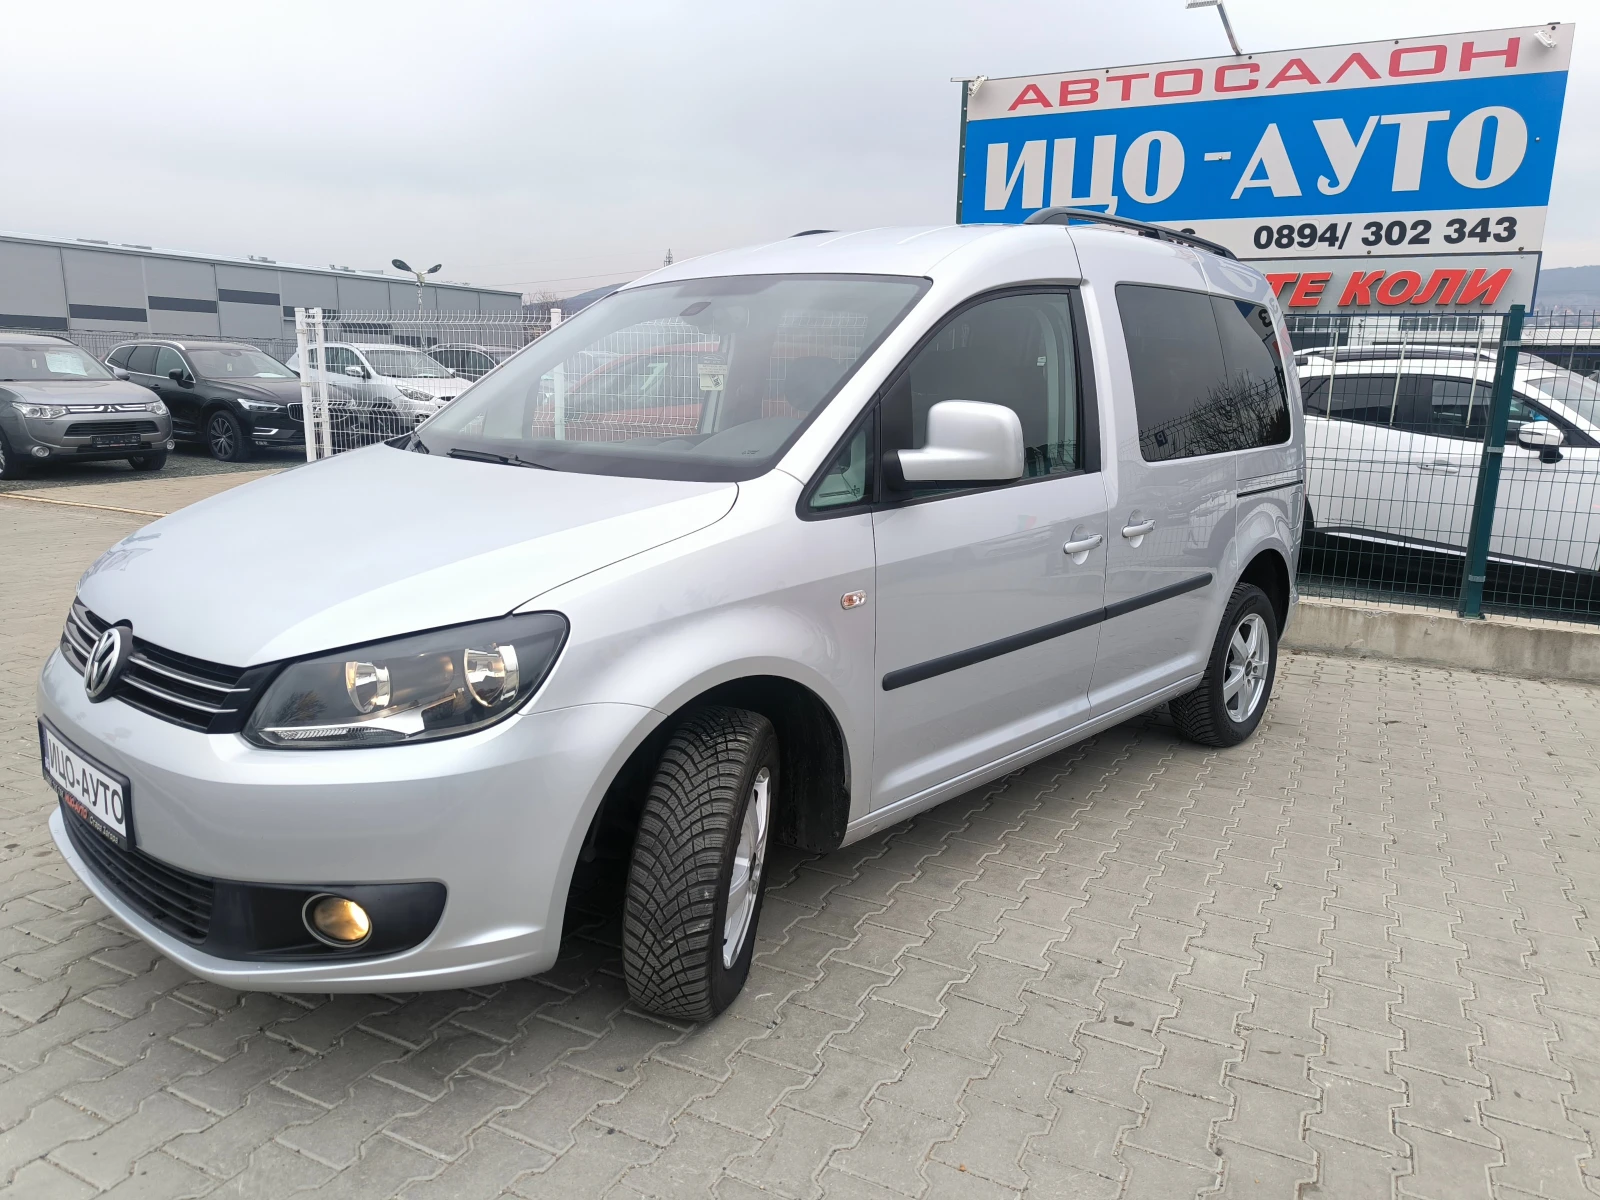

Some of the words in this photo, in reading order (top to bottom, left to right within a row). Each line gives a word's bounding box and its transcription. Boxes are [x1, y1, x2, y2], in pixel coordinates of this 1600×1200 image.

[1007, 37, 1521, 112] АВТОСАЛОН
[1253, 222, 1352, 250] 0894/
[1361, 220, 1432, 247] 302
[1443, 216, 1518, 244] 343
[1337, 268, 1513, 307] КОЛИ
[48, 738, 125, 825] ИЦО-АУТО
